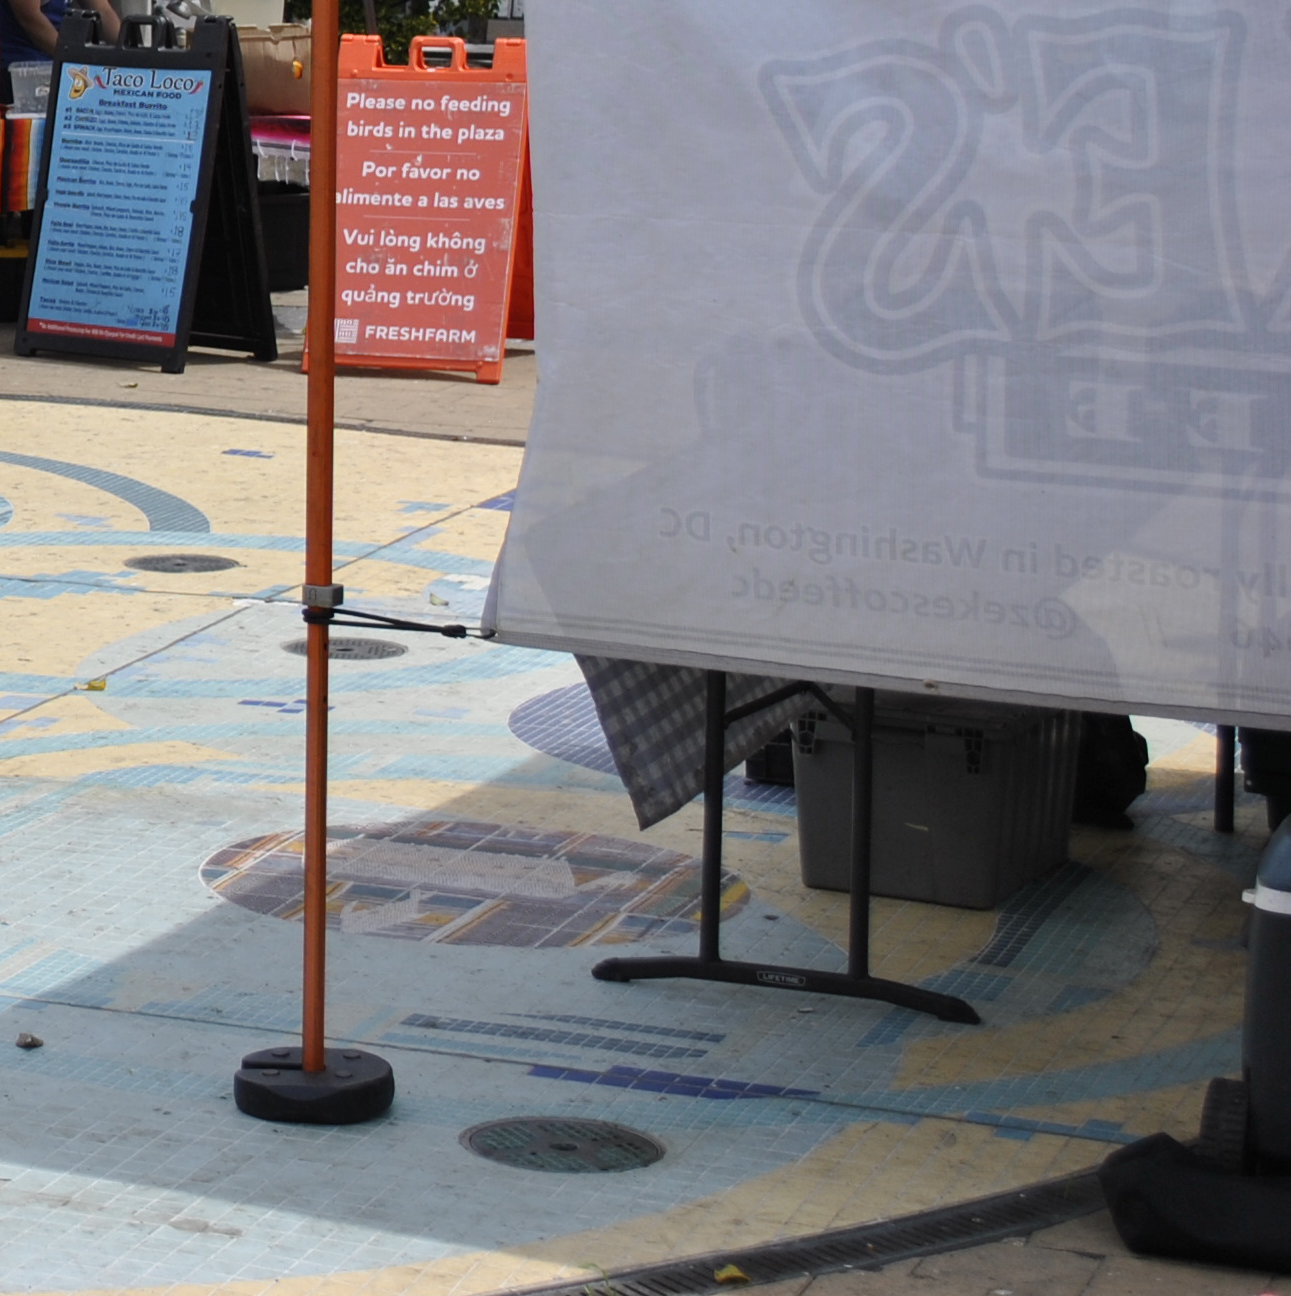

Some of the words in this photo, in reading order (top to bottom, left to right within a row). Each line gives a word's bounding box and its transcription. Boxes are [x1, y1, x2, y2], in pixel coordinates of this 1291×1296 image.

[101, 67, 144, 87] Taco
[149, 70, 194, 90] Loco
[98, 99, 136, 107] Breakfast
[113, 89, 153, 97] MEXICAN
[156, 91, 181, 99] FOOD
[347, 93, 405, 110] Please
[412, 99, 436, 111] no
[441, 96, 511, 117] feeding
[347, 121, 393, 137] birds
[399, 122, 415, 138] in
[421, 123, 453, 140] the
[458, 124, 505, 144] plaza
[362, 161, 396, 178] Por
[402, 162, 451, 180] favor
[457, 168, 480, 180] no
[335, 189, 412, 207] alimente
[418, 195, 428, 207] a
[434, 191, 458, 208] las
[464, 197, 504, 209] aves
[343, 229, 374, 245] Vui
[380, 229, 420, 251] lòng
[427, 231, 485, 254] không
[346, 259, 379, 274] cho
[385, 259, 407, 276] ăn
[413, 260, 458, 278] chim
[465, 259, 477, 278] ở
[341, 284, 399, 307] quảng
[406, 288, 474, 310] trường
[365, 325, 476, 343] FRESHFARM
